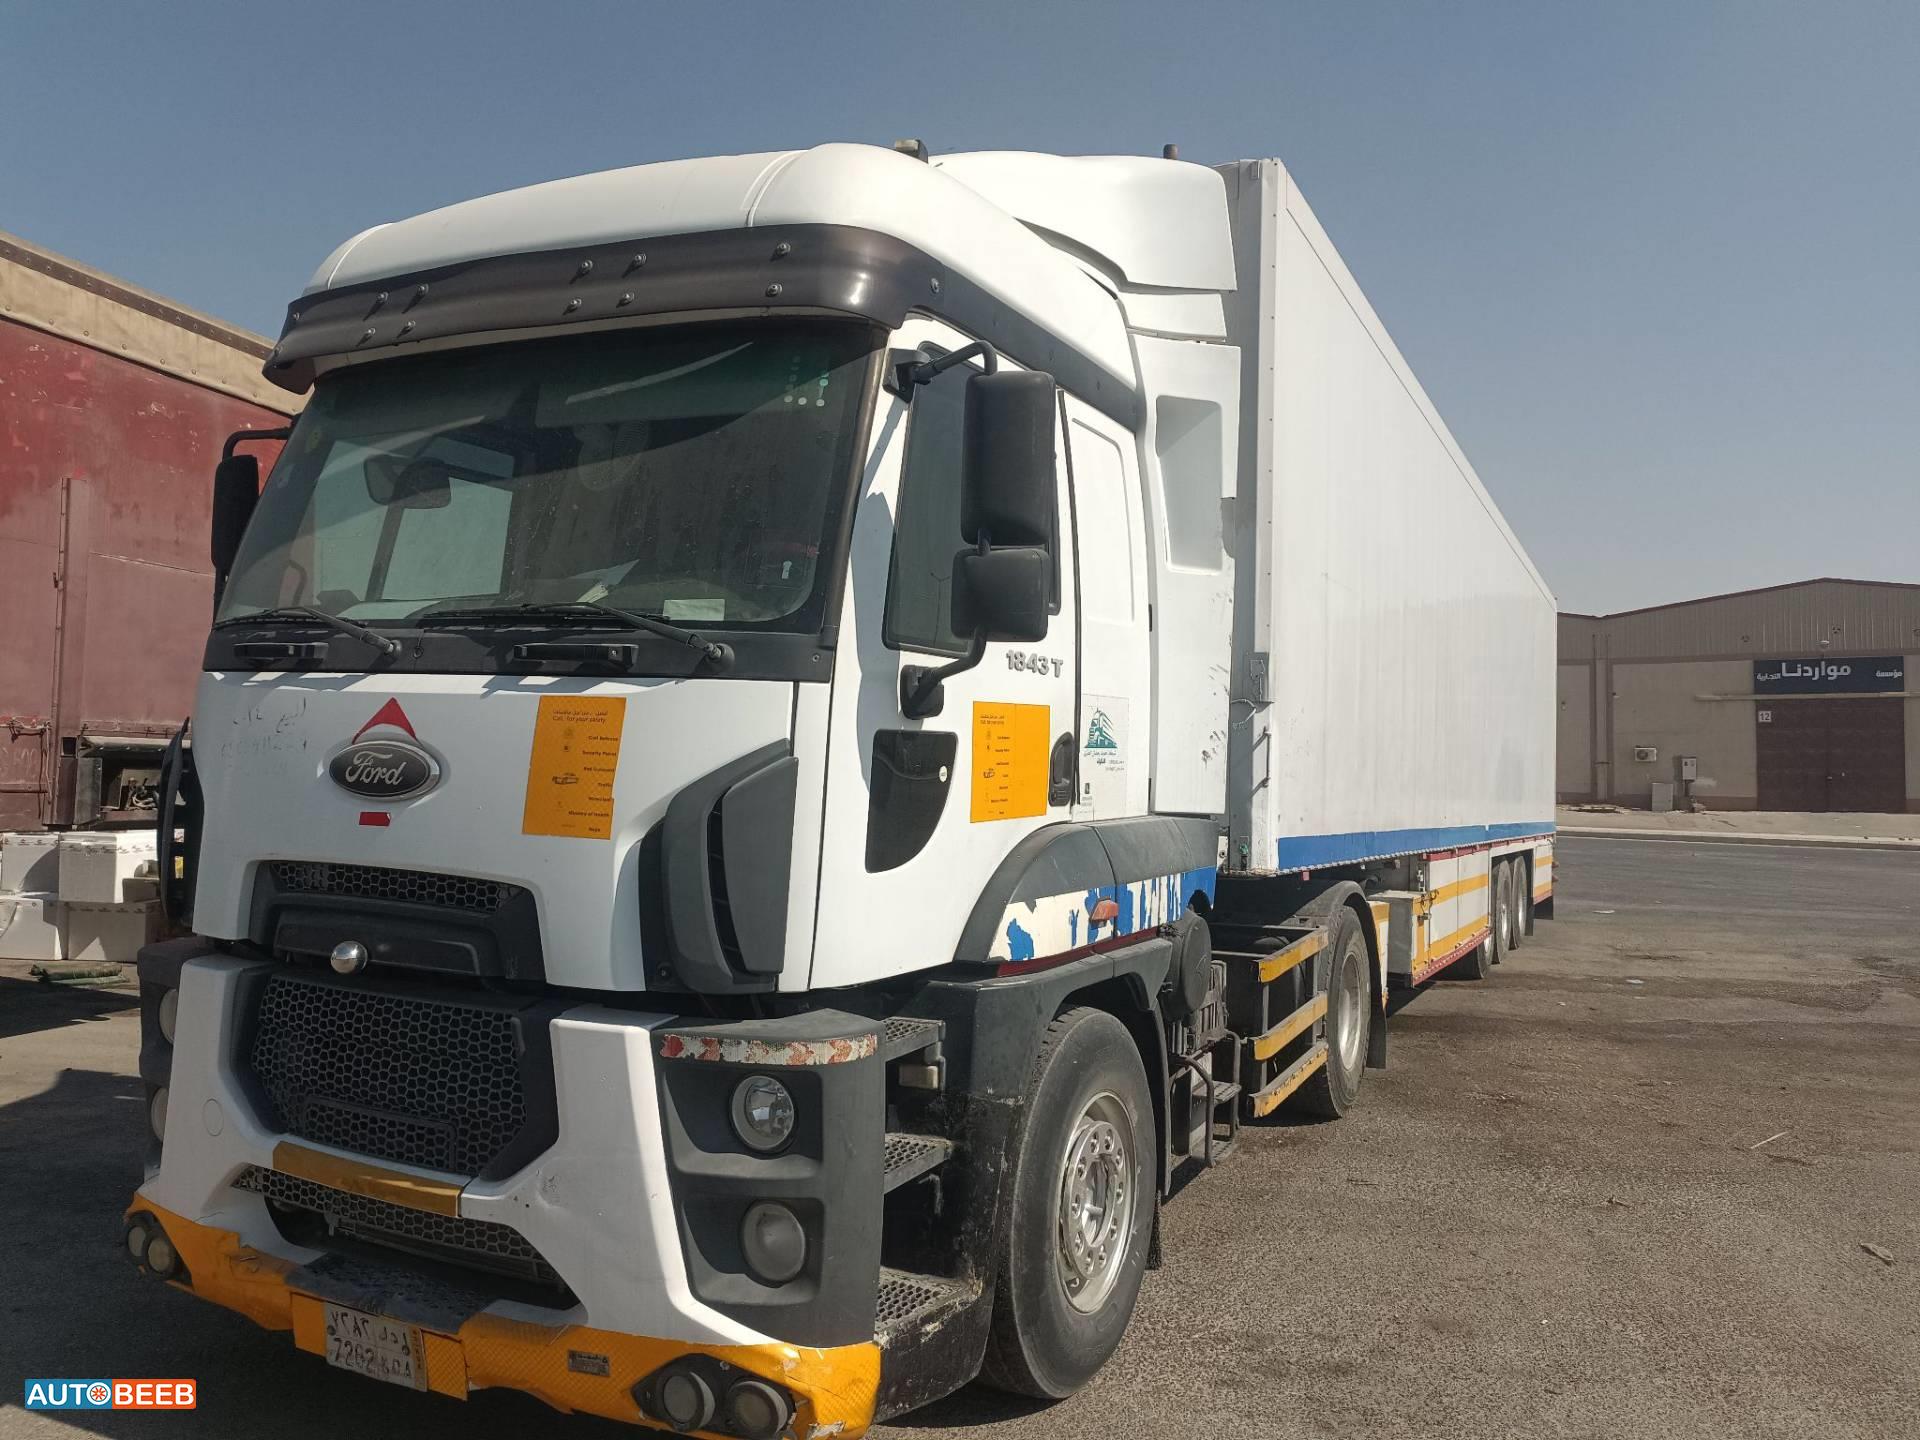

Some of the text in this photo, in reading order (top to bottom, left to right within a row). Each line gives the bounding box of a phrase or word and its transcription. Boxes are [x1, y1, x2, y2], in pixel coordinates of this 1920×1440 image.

[1781, 660, 1852, 681] مواردنا
[1759, 712, 1771, 722] 12
[345, 750, 407, 786] Ford
